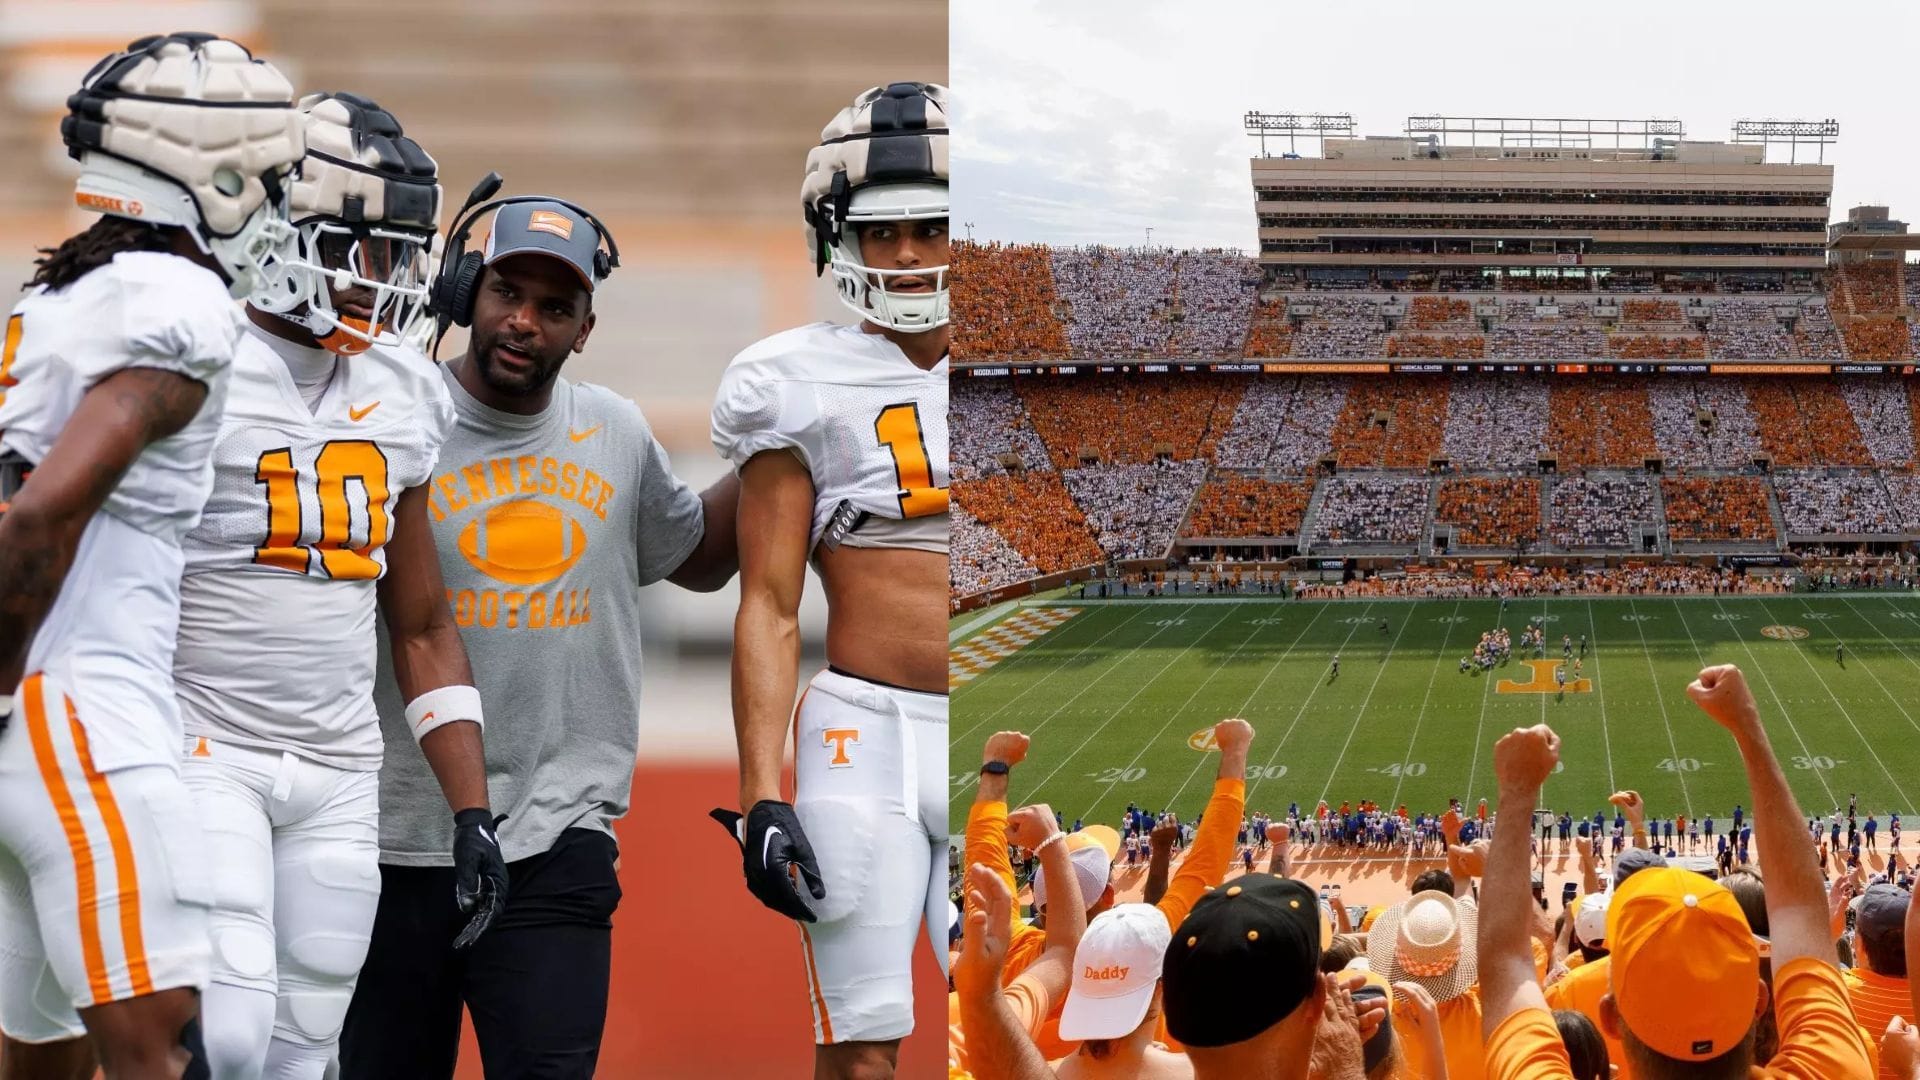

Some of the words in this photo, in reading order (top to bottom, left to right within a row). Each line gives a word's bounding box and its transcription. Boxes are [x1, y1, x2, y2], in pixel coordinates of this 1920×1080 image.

[874, 402, 949, 520] 1
[251, 440, 390, 580] 10
[446, 588, 592, 629] OOTBALL
[823, 728, 860, 767] T
[1380, 762, 1427, 777] 40
[1656, 757, 1700, 772] 40
[1791, 756, 1836, 770] 30
[1096, 767, 1147, 783] 20
[1084, 966, 1129, 980] Daddy
